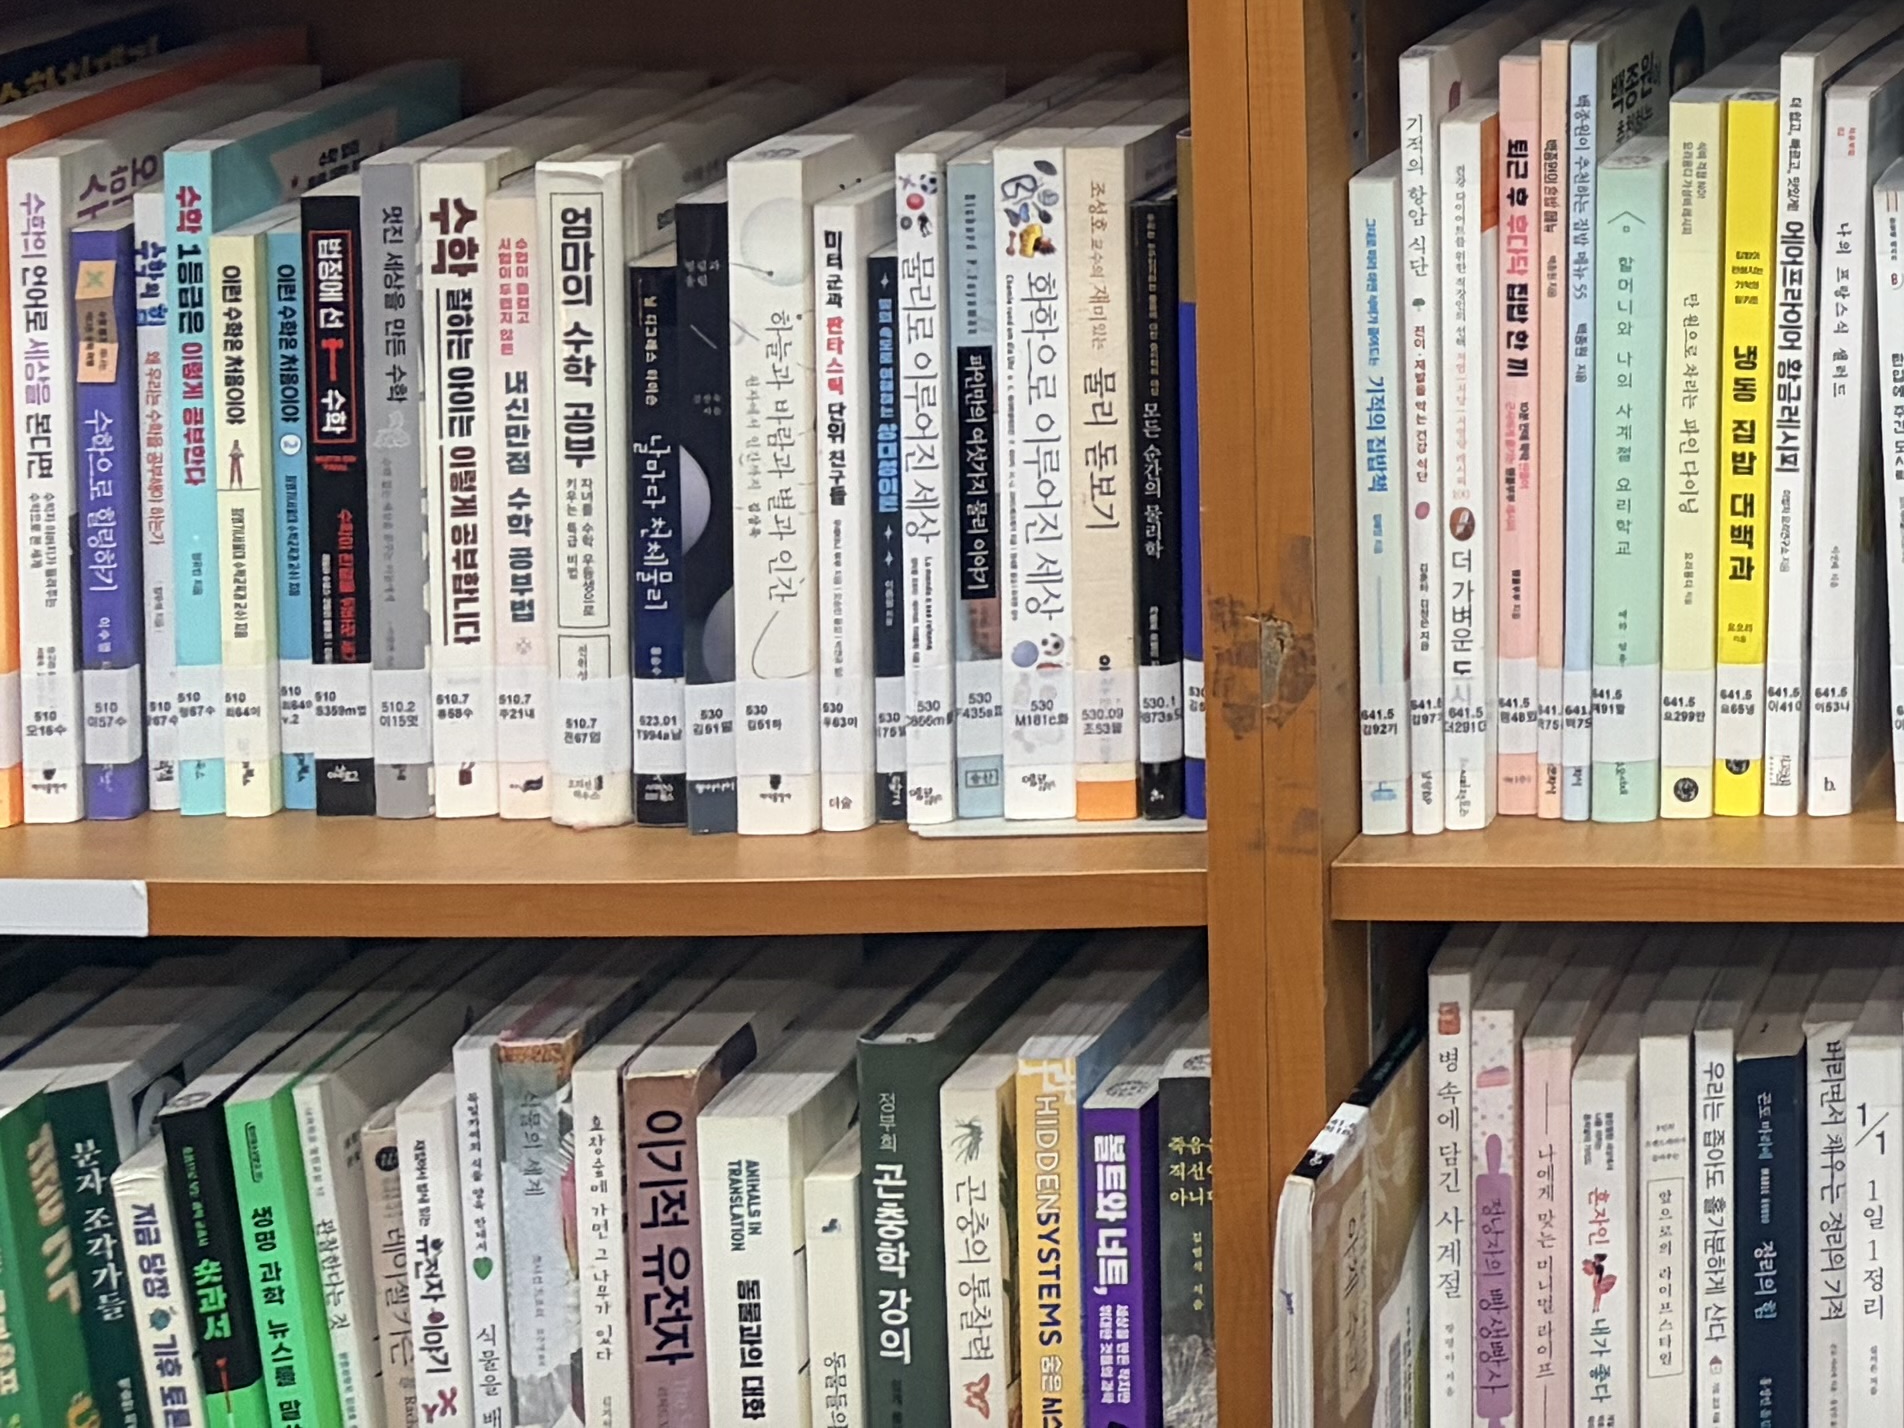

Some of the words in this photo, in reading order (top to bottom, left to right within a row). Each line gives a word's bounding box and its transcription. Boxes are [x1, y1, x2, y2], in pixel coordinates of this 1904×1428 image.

[1720, 690, 1752, 700] 641.5
[638, 1111, 690, 1229] 이기적
[873, 1164, 909, 1278] 곤충학
[642, 1243, 694, 1366] 유전자
[879, 1289, 911, 1364] 강의
